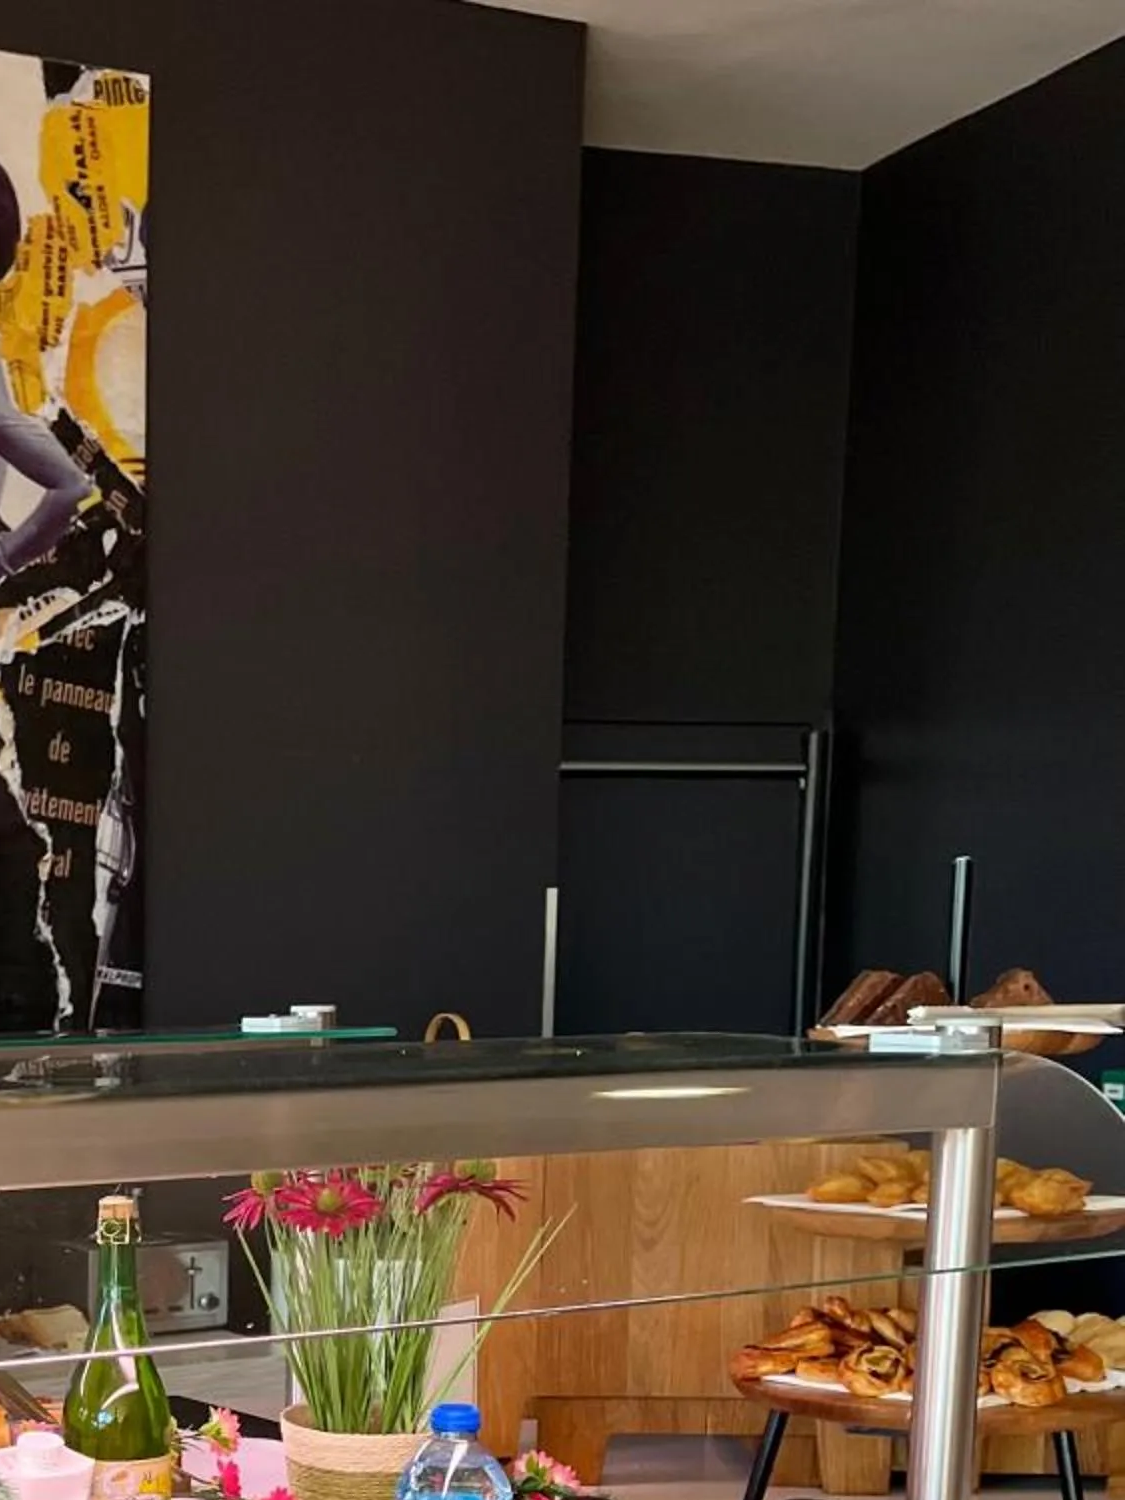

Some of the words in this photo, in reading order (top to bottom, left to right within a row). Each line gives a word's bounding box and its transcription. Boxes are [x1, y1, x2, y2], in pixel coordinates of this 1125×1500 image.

[56, 628, 96, 651] vec
[17, 664, 35, 694] le
[41, 677, 115, 714] panneau
[48, 731, 71, 763] de
